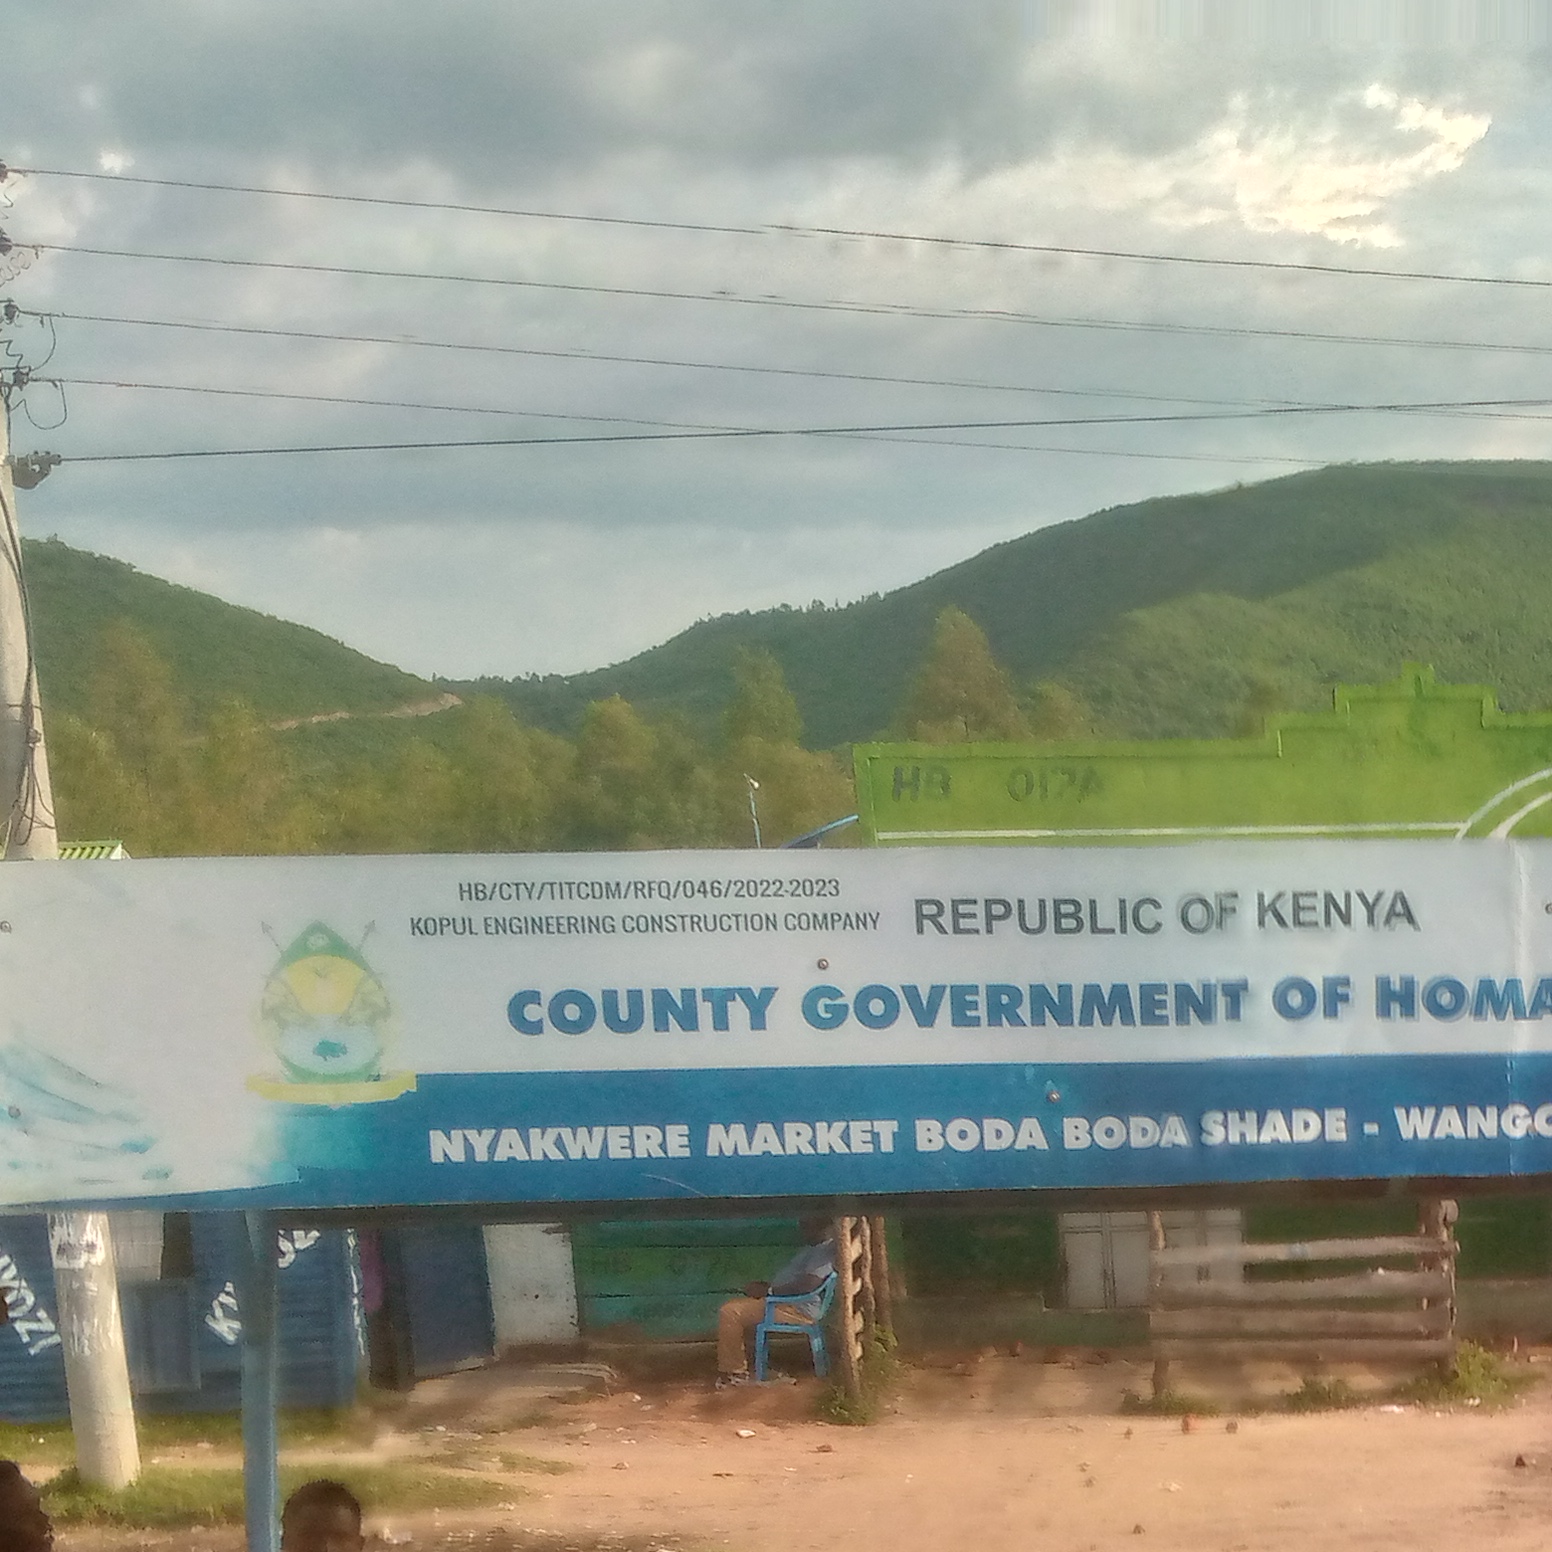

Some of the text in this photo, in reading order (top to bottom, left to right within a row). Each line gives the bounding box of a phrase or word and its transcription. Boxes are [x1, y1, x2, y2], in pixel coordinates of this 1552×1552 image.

[410, 911, 880, 936] KOPUL ENGINEERING CONSTRUCTION COMPANY
[914, 889, 1420, 935] REPUBLIC OF KENYA
[507, 986, 778, 1036] COUNTY
[802, 982, 1248, 1030] GOVERNMENT
[1272, 976, 1353, 1021] OF
[429, 1125, 690, 1164] NYAKWERE
[706, 1120, 899, 1157] MARKET
[915, 1116, 1049, 1153] BODA
[1063, 1113, 1190, 1151] BODA
[1200, 1108, 1347, 1146] SHADE
